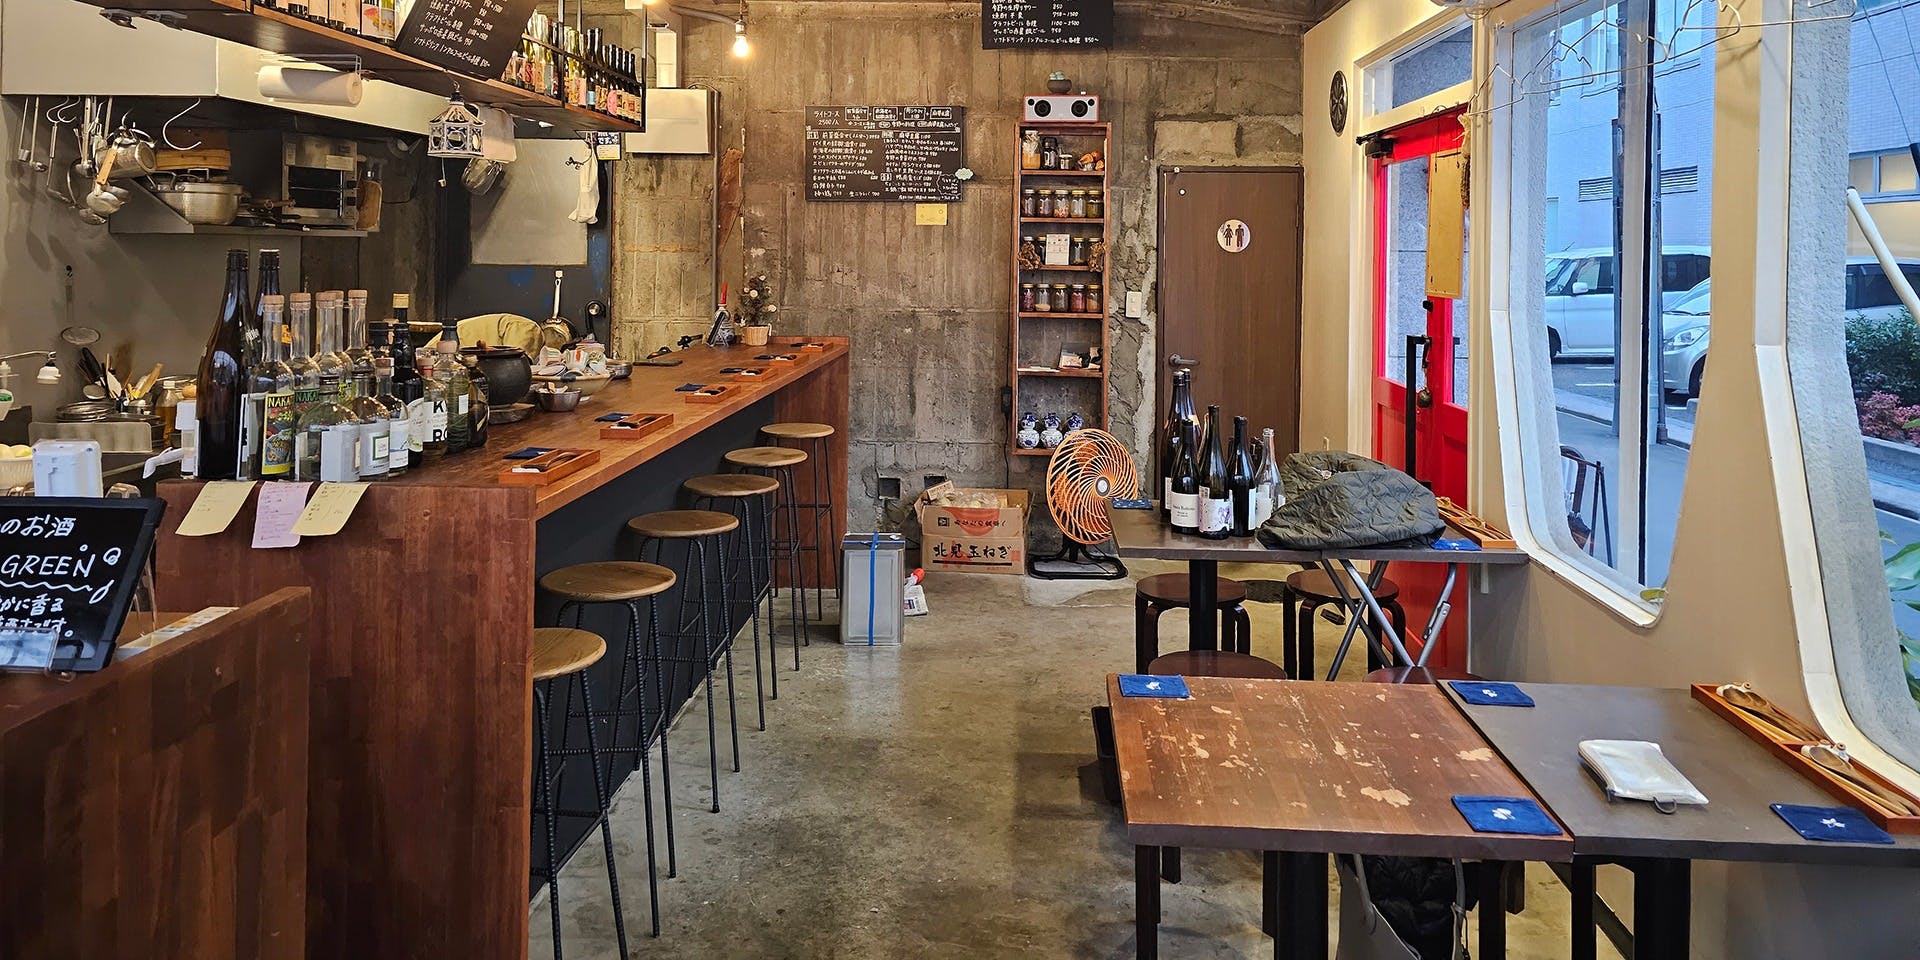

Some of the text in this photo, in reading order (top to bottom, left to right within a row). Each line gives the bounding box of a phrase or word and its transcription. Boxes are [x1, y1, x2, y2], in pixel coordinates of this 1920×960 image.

[0, 514, 77, 538] のお酒
[1, 553, 96, 578] GREEN
